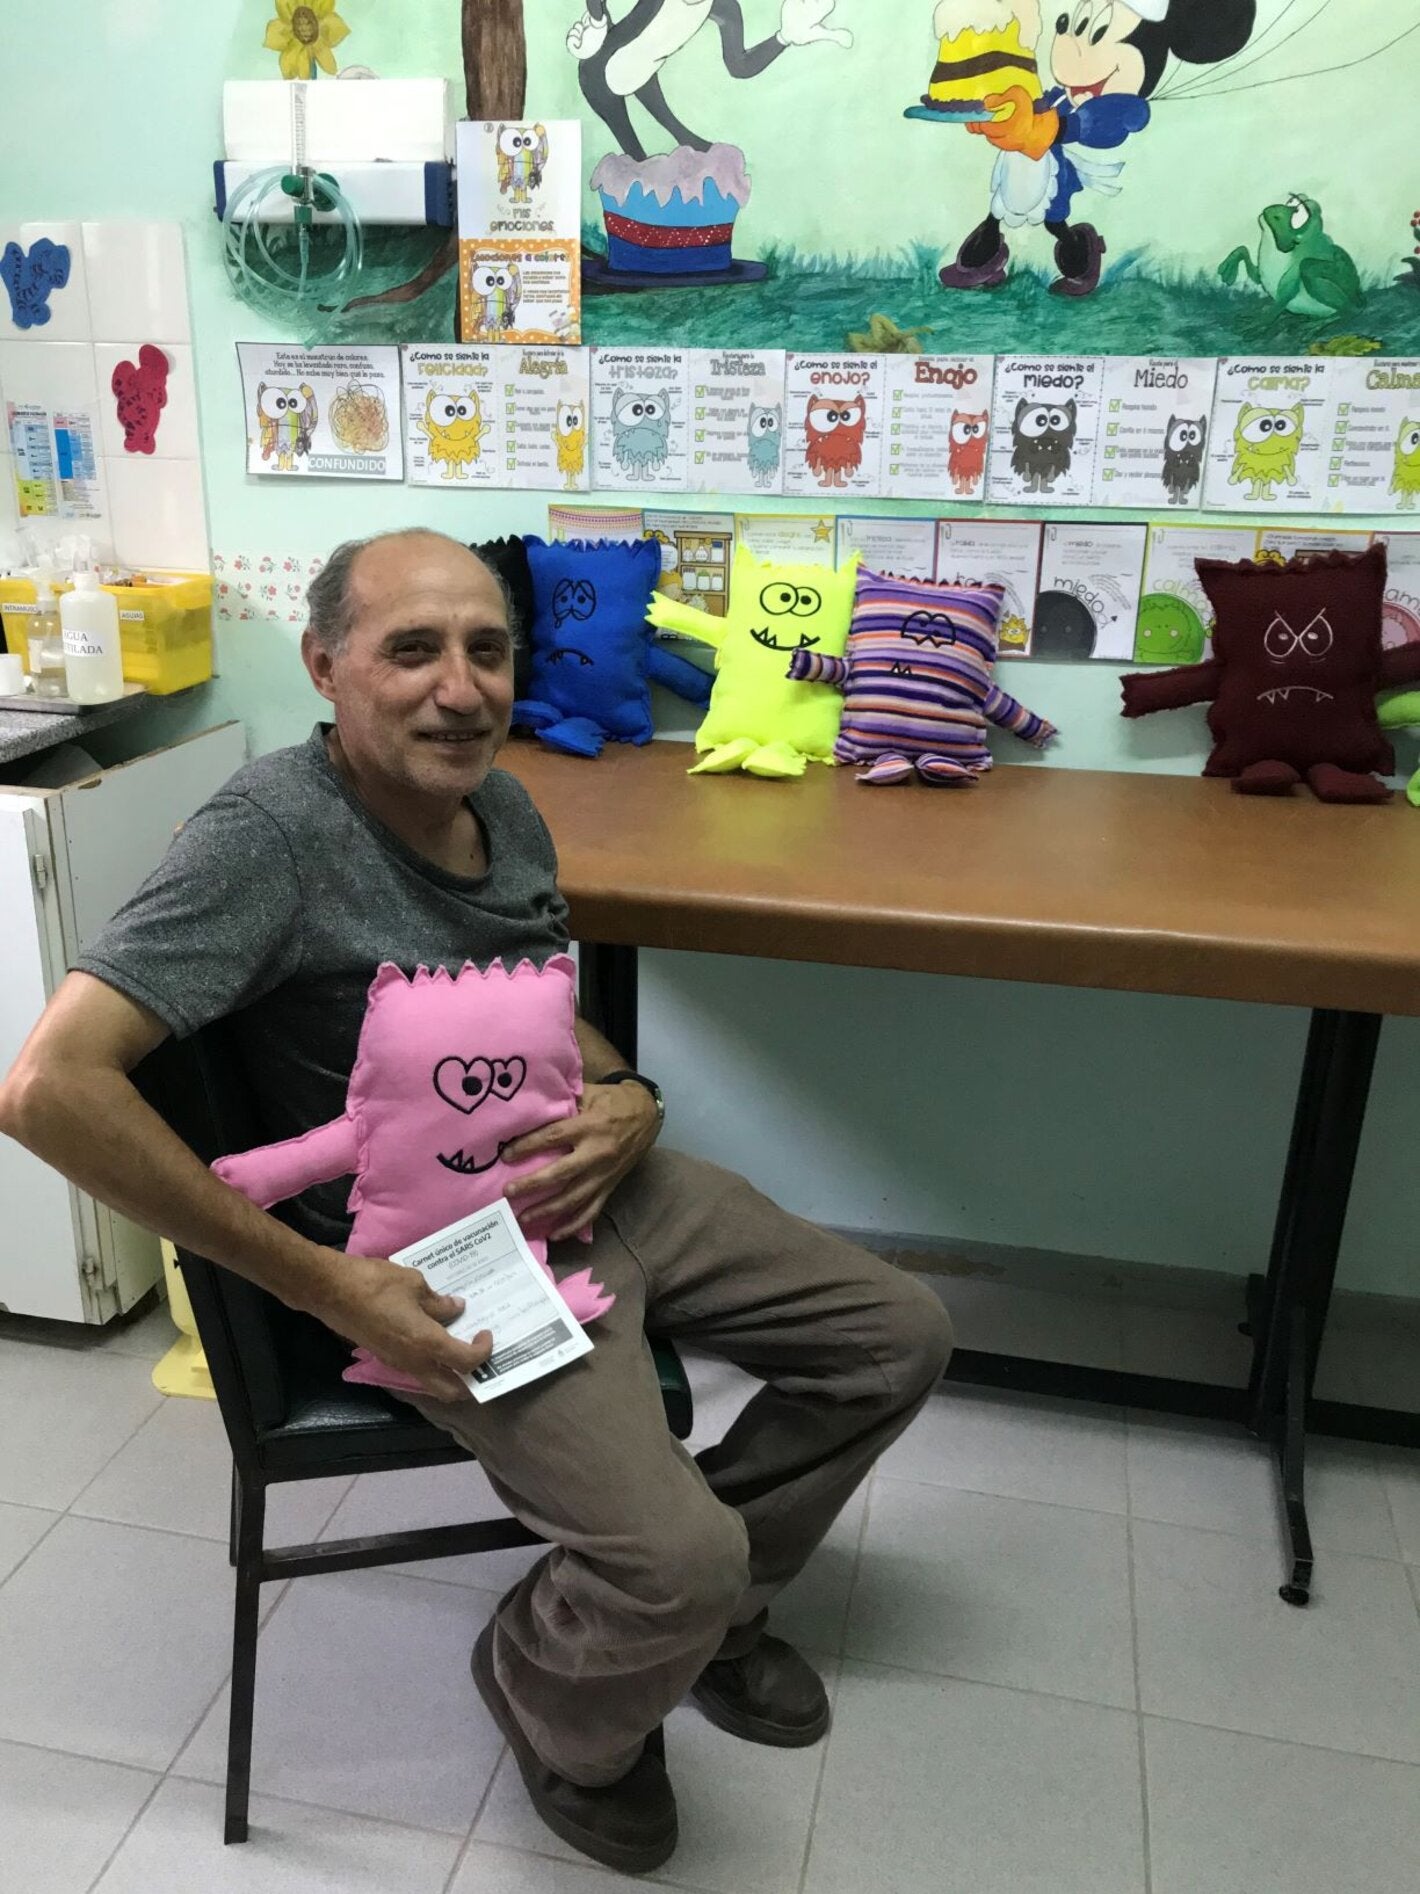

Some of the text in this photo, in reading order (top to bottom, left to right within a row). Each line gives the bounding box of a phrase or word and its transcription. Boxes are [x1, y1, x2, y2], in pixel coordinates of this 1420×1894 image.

[490, 221, 554, 231] emociones
[444, 352, 454, 361] se
[455, 352, 479, 361] siente
[480, 352, 490, 361] la
[635, 355, 644, 363] se
[646, 354, 671, 363] siente
[673, 354, 682, 363] la
[710, 359, 766, 376] Tristeza
[831, 361, 840, 369] se
[843, 360, 868, 369] siente
[870, 360, 878, 369] el
[1044, 363, 1054, 372] se
[1057, 363, 1084, 372] siente
[1086, 362, 1095, 373] el
[1269, 365, 1281, 373] se
[1283, 364, 1312, 374] siente
[1315, 364, 1325, 373] la
[609, 365, 678, 379] tristeza?
[810, 372, 871, 386] enojo?
[914, 361, 977, 390] Enojo
[1134, 367, 1188, 389] Miedo
[1024, 374, 1084, 389] miedo?
[309, 457, 385, 472] CONFUNDIDO
[1054, 576, 1105, 614] miedo
[412, 1220, 499, 1267] Carnet único de vacunación
[427, 1232, 491, 1270] contra el SARS CoV2
